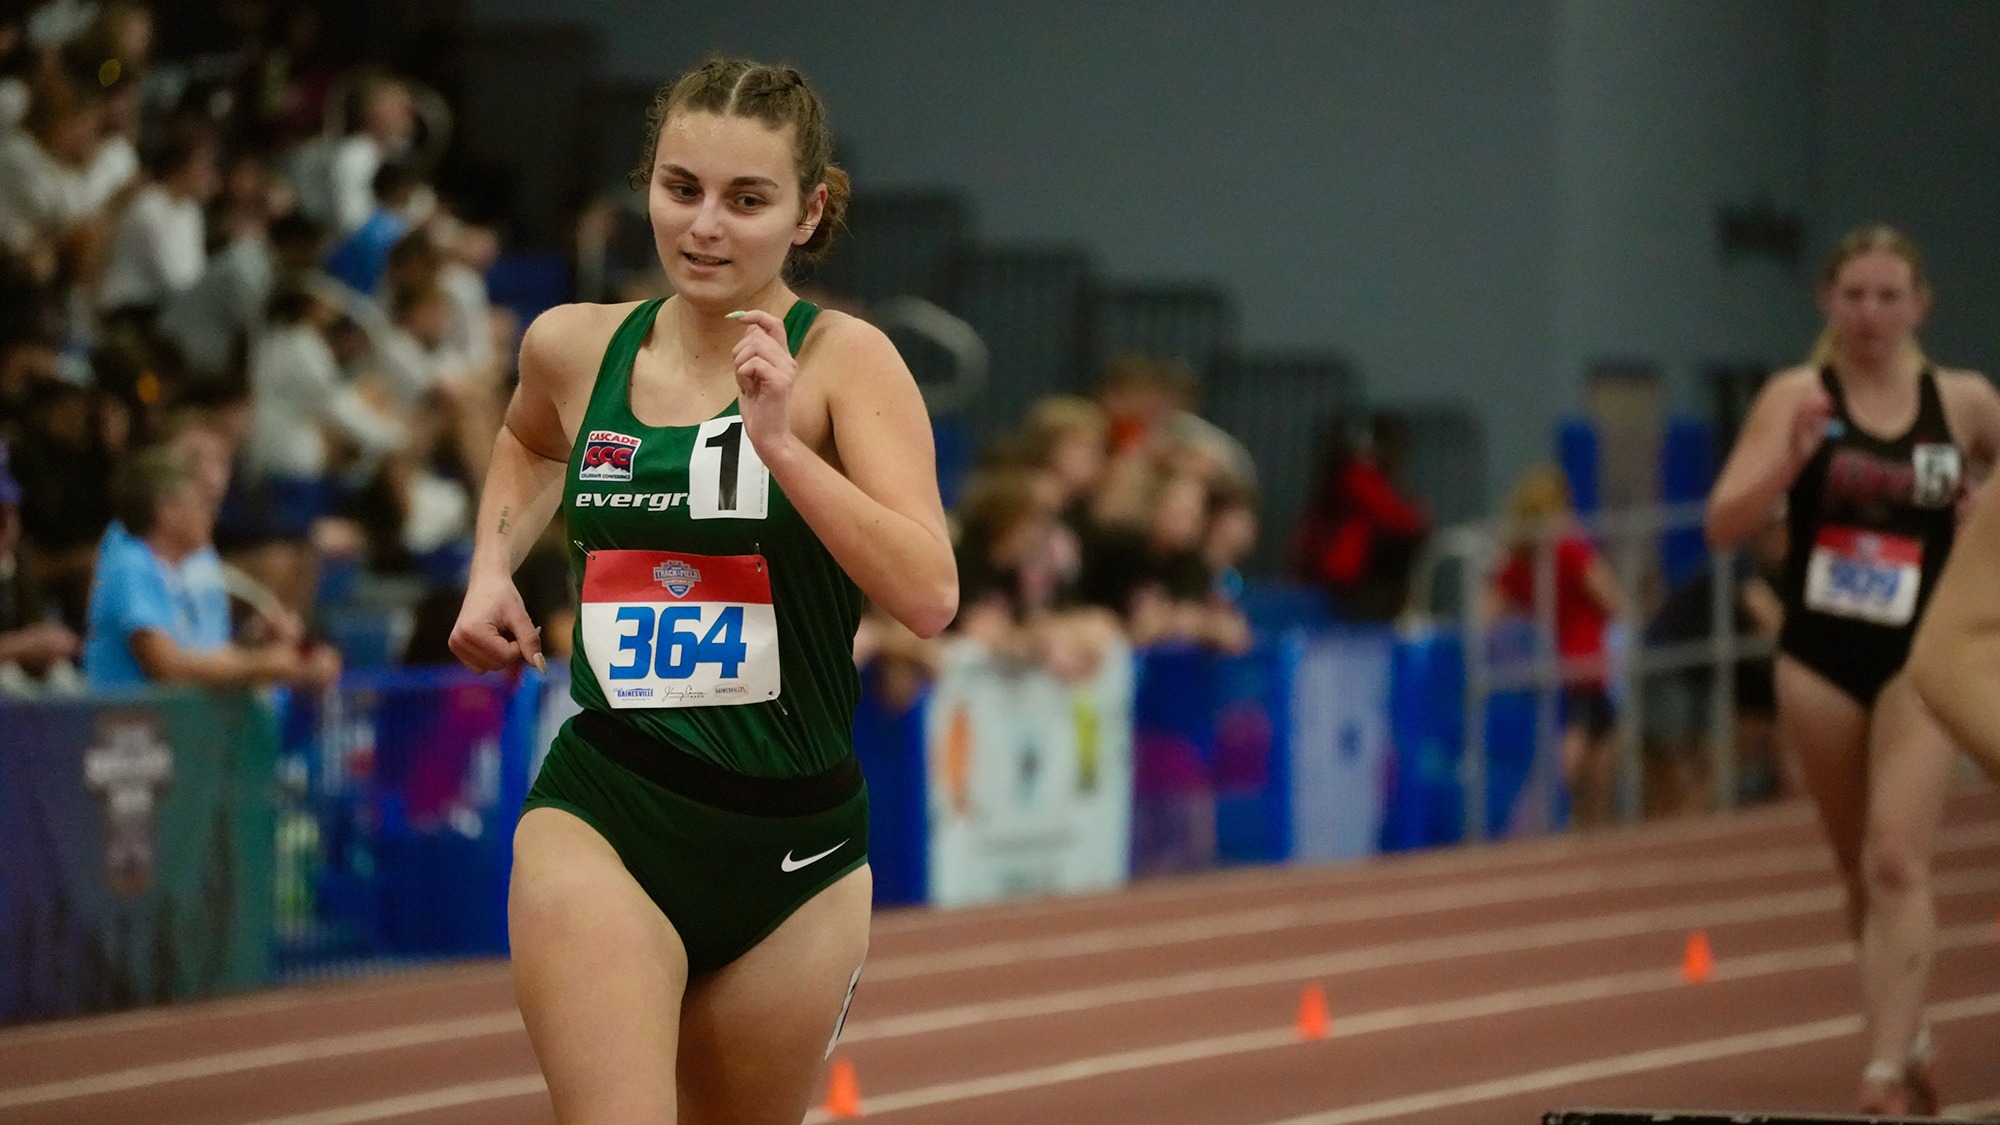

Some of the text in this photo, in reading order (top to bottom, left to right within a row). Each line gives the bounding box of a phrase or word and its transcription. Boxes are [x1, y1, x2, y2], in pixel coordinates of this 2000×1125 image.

[589, 432, 640, 447] CASCADE
[585, 445, 634, 467] CCC
[705, 421, 744, 511] 1
[575, 492, 691, 512] evergr
[609, 606, 747, 680] 364
[617, 689, 654, 697] GAINESVILLE
